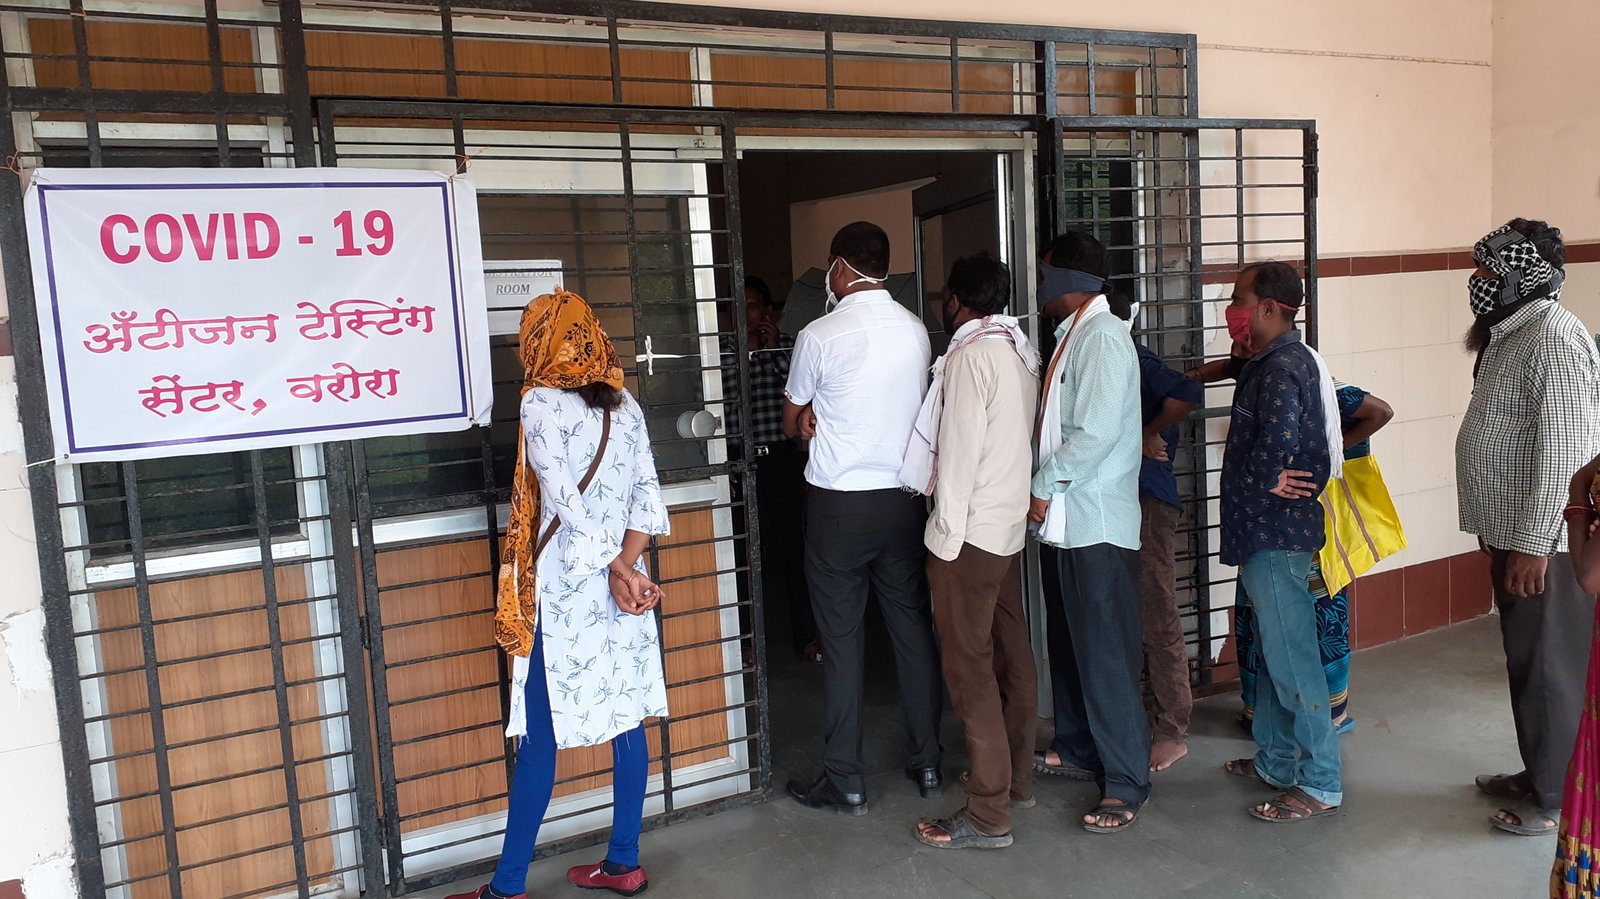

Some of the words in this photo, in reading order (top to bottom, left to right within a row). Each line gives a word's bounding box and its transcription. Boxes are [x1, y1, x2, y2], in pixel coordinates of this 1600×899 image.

[99, 211, 282, 265] COVID
[332, 209, 395, 257] 19
[496, 284, 530, 294] ROOM
[295, 297, 437, 341] टेस्टिंग
[138, 374, 268, 418] सेंटर,
[287, 361, 401, 403] वरोरा
